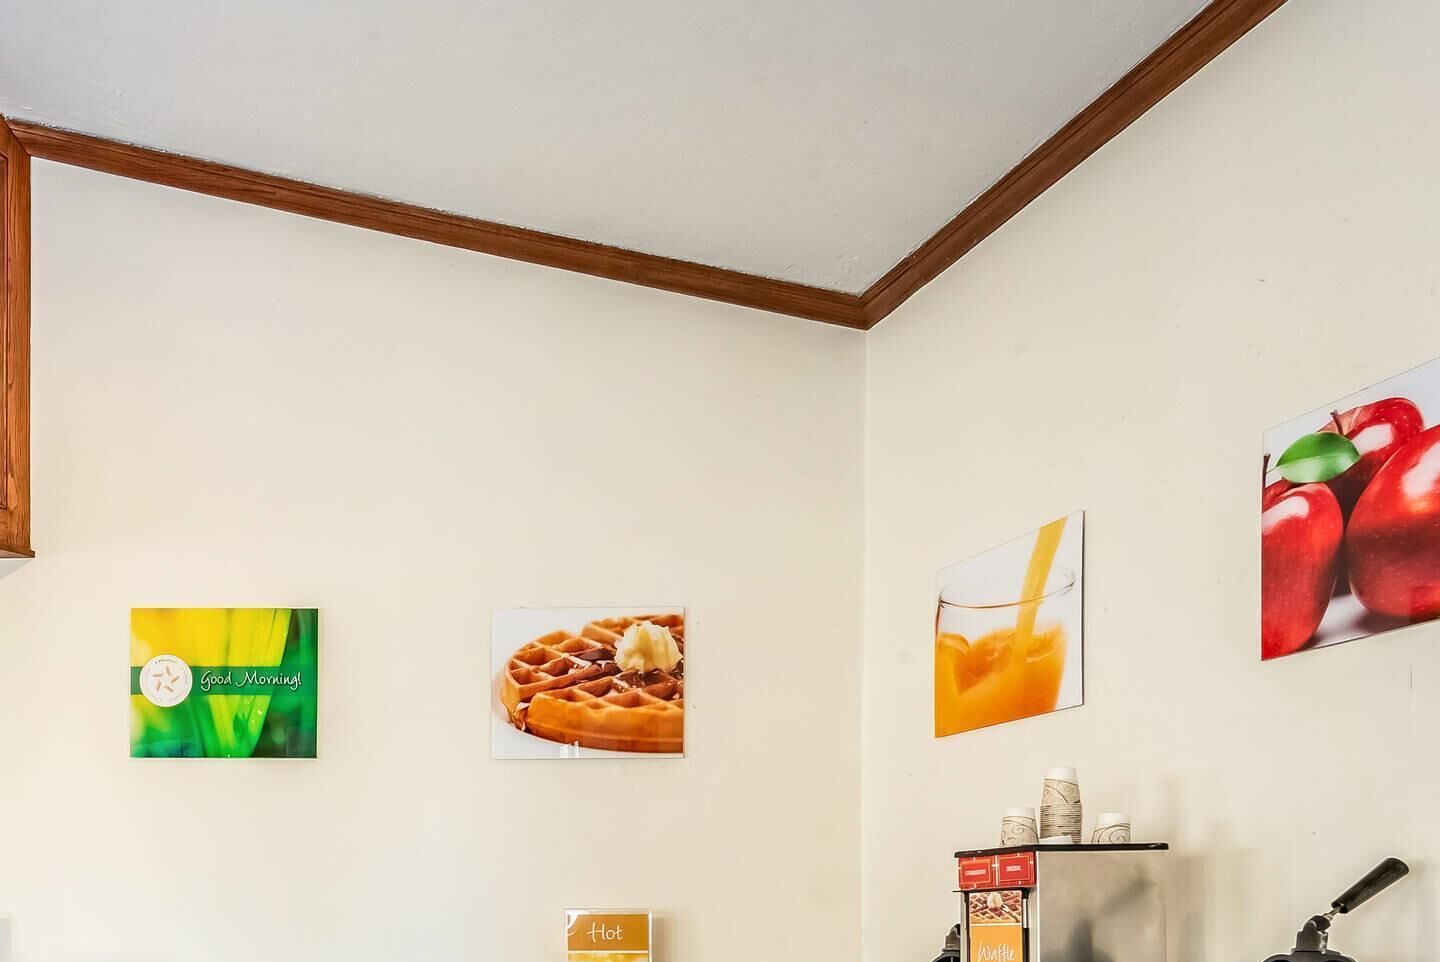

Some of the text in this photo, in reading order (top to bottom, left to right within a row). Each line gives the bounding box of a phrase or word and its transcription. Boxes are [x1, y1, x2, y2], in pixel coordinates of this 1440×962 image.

[200, 671, 232, 692] Good
[235, 670, 302, 691] Morning!
[586, 921, 624, 943] Hot
